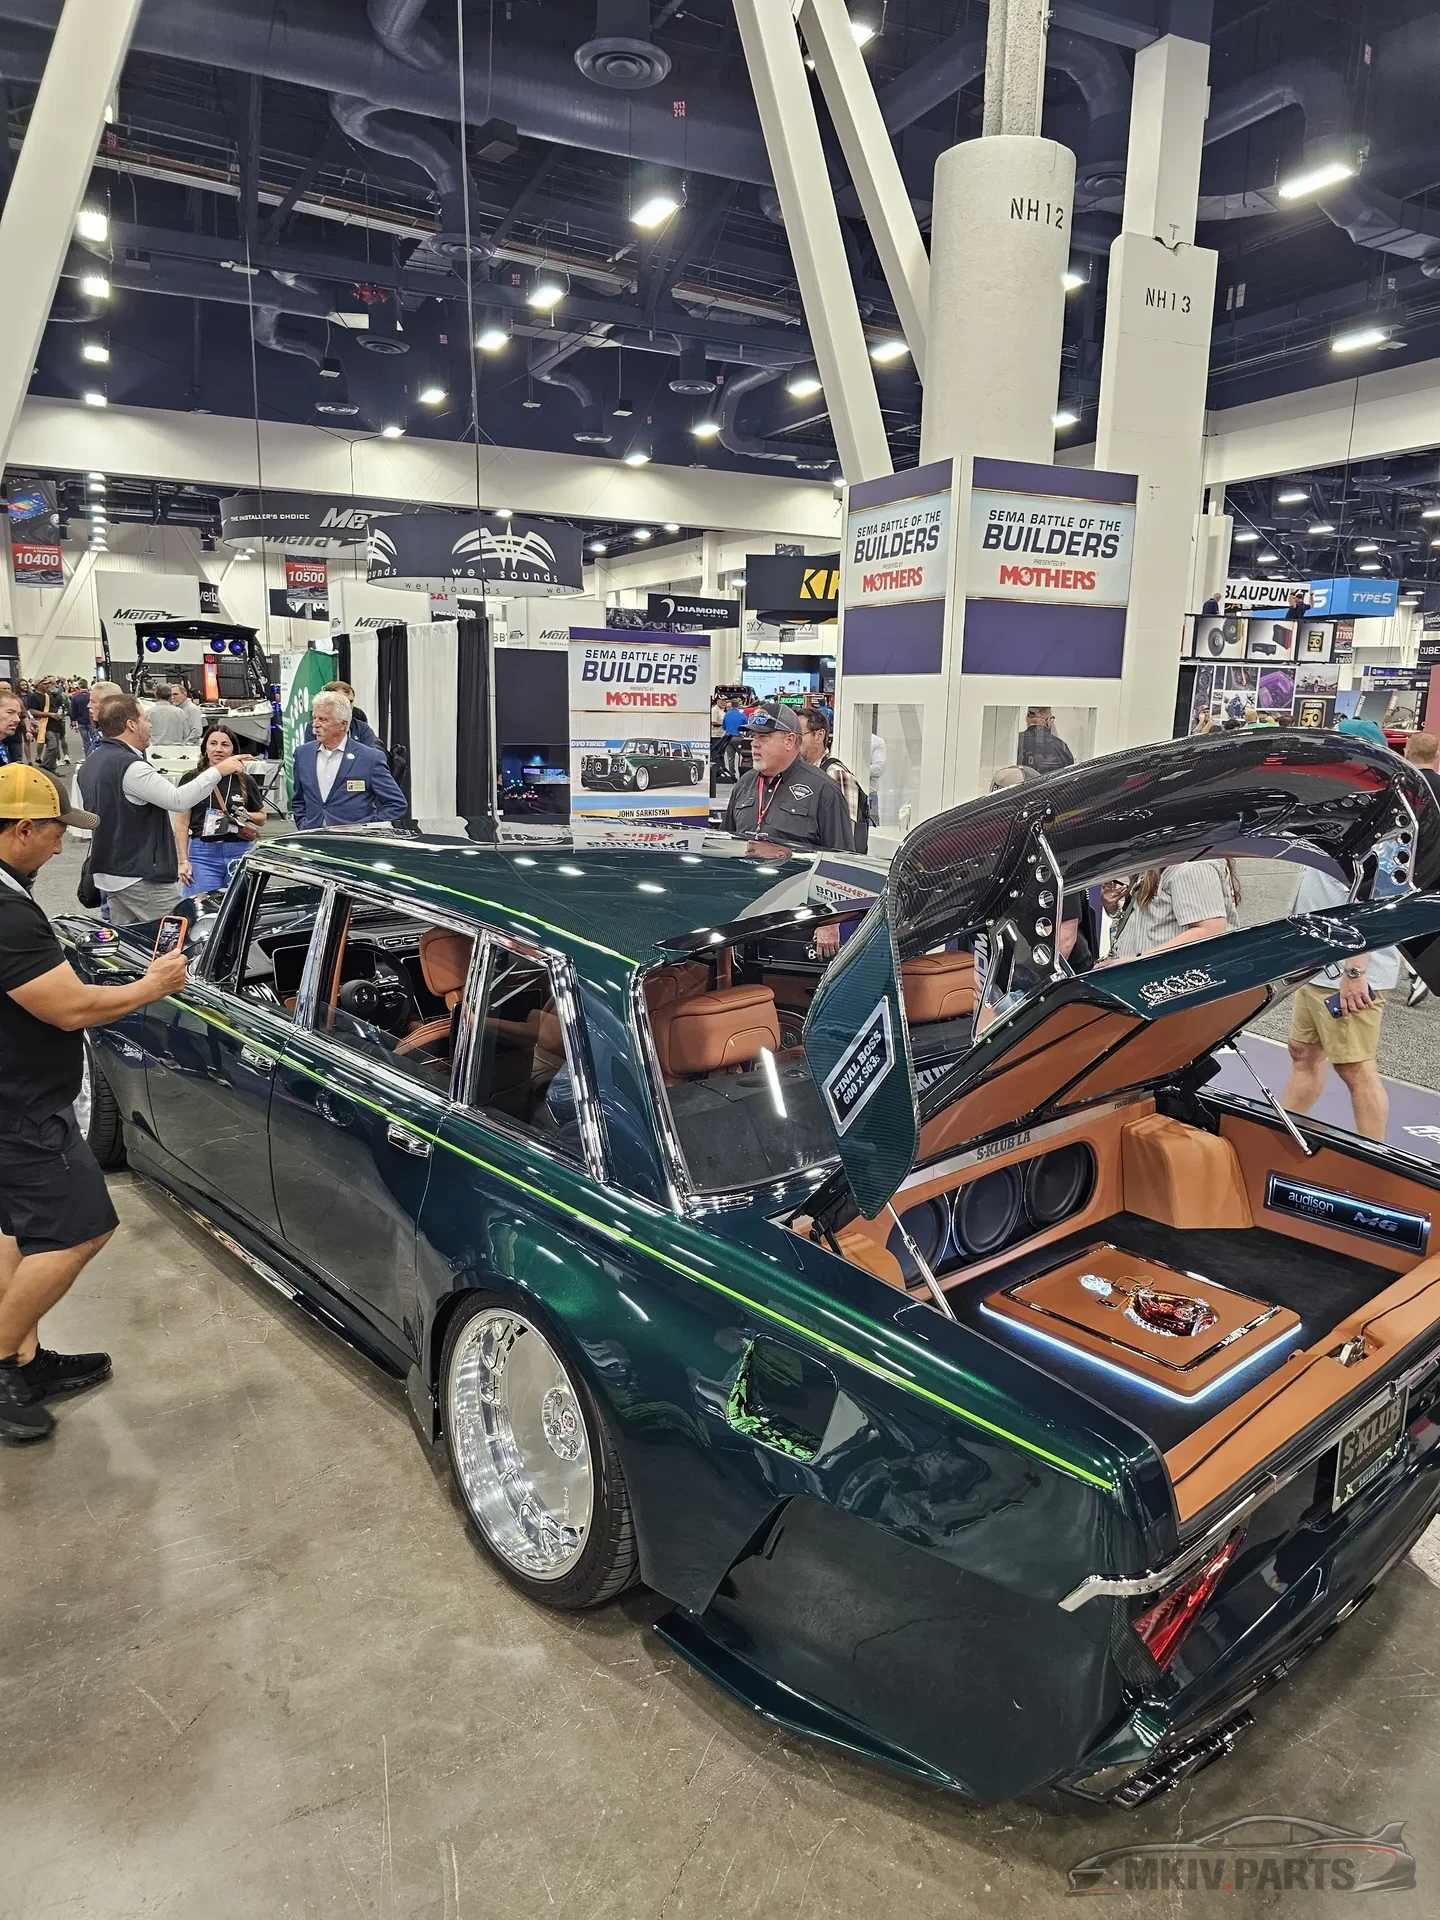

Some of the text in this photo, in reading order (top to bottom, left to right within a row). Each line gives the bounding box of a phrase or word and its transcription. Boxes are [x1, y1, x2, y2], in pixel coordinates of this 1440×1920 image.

[1010, 198, 1064, 229] NH12
[1146, 288, 1191, 313] NH13
[239, 513, 278, 521] INSTALLER'S
[857, 510, 942, 538] SEMA BATTLE OF THE
[988, 509, 1122, 532] SEMA BATTLE OF THE
[853, 524, 940, 564] BUILDERS
[982, 523, 1120, 559] BUILDERS
[16, 552, 59, 567] 10400
[1033, 558, 1057, 567] PRESENTED
[288, 571, 325, 583] 10500
[441, 583, 500, 594] sounds
[500, 571, 558, 583] sounds
[862, 566, 923, 593] MOTHERS
[999, 565, 1096, 591] MOTHERS
[677, 605, 729, 616] DIAMOND
[585, 649, 698, 663] SEMA BATTLE OF THE
[582, 660, 698, 685] BUILDERS
[606, 691, 677, 707] MOTHERS
[617, 808, 670, 818] JOHN SARKISYAN
[833, 1029, 882, 1100] FINAL BOSS
[843, 1082, 858, 1105] 600
[856, 1075, 865, 1088] x
[976, 1130, 1032, 1162] S-KLUB LA
[1288, 1191, 1334, 1213] audison
